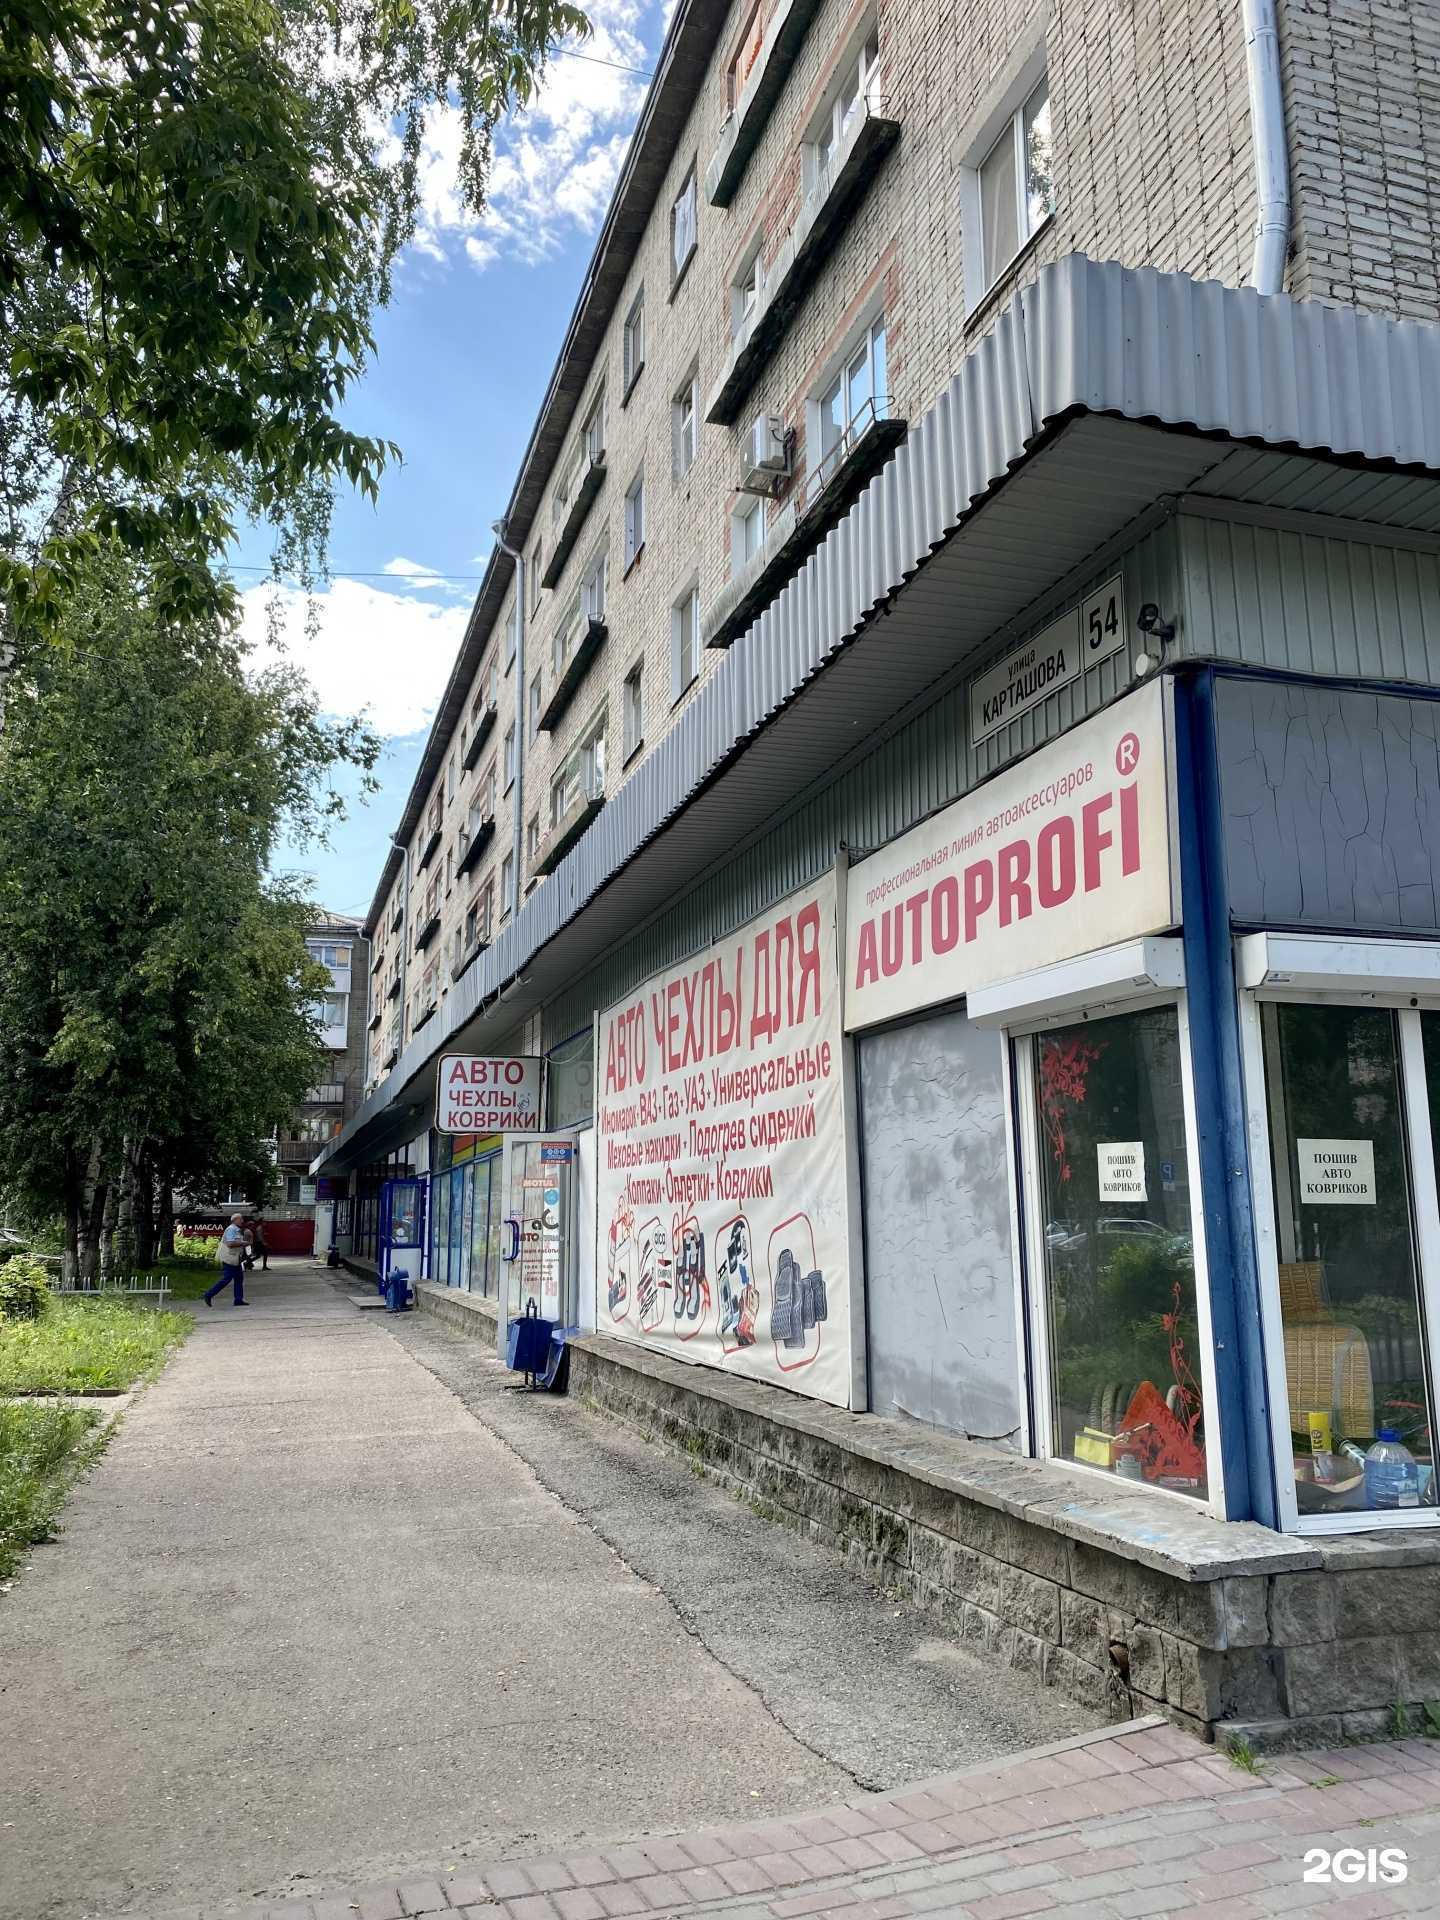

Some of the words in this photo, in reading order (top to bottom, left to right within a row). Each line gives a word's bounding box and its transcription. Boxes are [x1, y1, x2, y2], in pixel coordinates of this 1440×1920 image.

[1088, 595, 1118, 650] 54
[1007, 649, 1036, 680] улица
[983, 648, 1066, 726] КАРТАШОВА
[866, 845, 949, 906] профессиональная
[951, 825, 984, 858] линия
[986, 763, 1093, 838] автоаксессуаров
[605, 1002, 646, 1096] АВТО
[653, 946, 743, 1074] ЧЕХЛЫ
[749, 900, 822, 1050] ДЛЯ
[449, 1060, 524, 1085] АВТО
[449, 1090, 517, 1107] ЧЕХЛЫ
[601, 1105, 637, 1139] Иномарок
[639, 1089, 658, 1126] ВАЗ
[663, 1084, 679, 1120] Газ
[684, 1072, 706, 1114] УАЗ
[712, 1040, 831, 1108] Универсальные
[448, 1111, 536, 1128] КОВРИКИ
[607, 1139, 643, 1170] Меховые
[645, 1133, 681, 1168] накидки
[689, 1118, 746, 1163] Подогрев
[749, 1089, 816, 1152] сидений
[1107, 1155, 1136, 1165] ПОШИВ
[1314, 1153, 1358, 1164] ПОШИВ
[626, 1173, 661, 1204] Колпаки
[716, 1160, 774, 1210] Коврики
[1112, 1169, 1132, 1178] АВТО
[1322, 1168, 1351, 1179] АВТО
[1104, 1182, 1142, 1192] КОВРИКОВ
[1307, 1183, 1368, 1194] КОВРИКОВ
